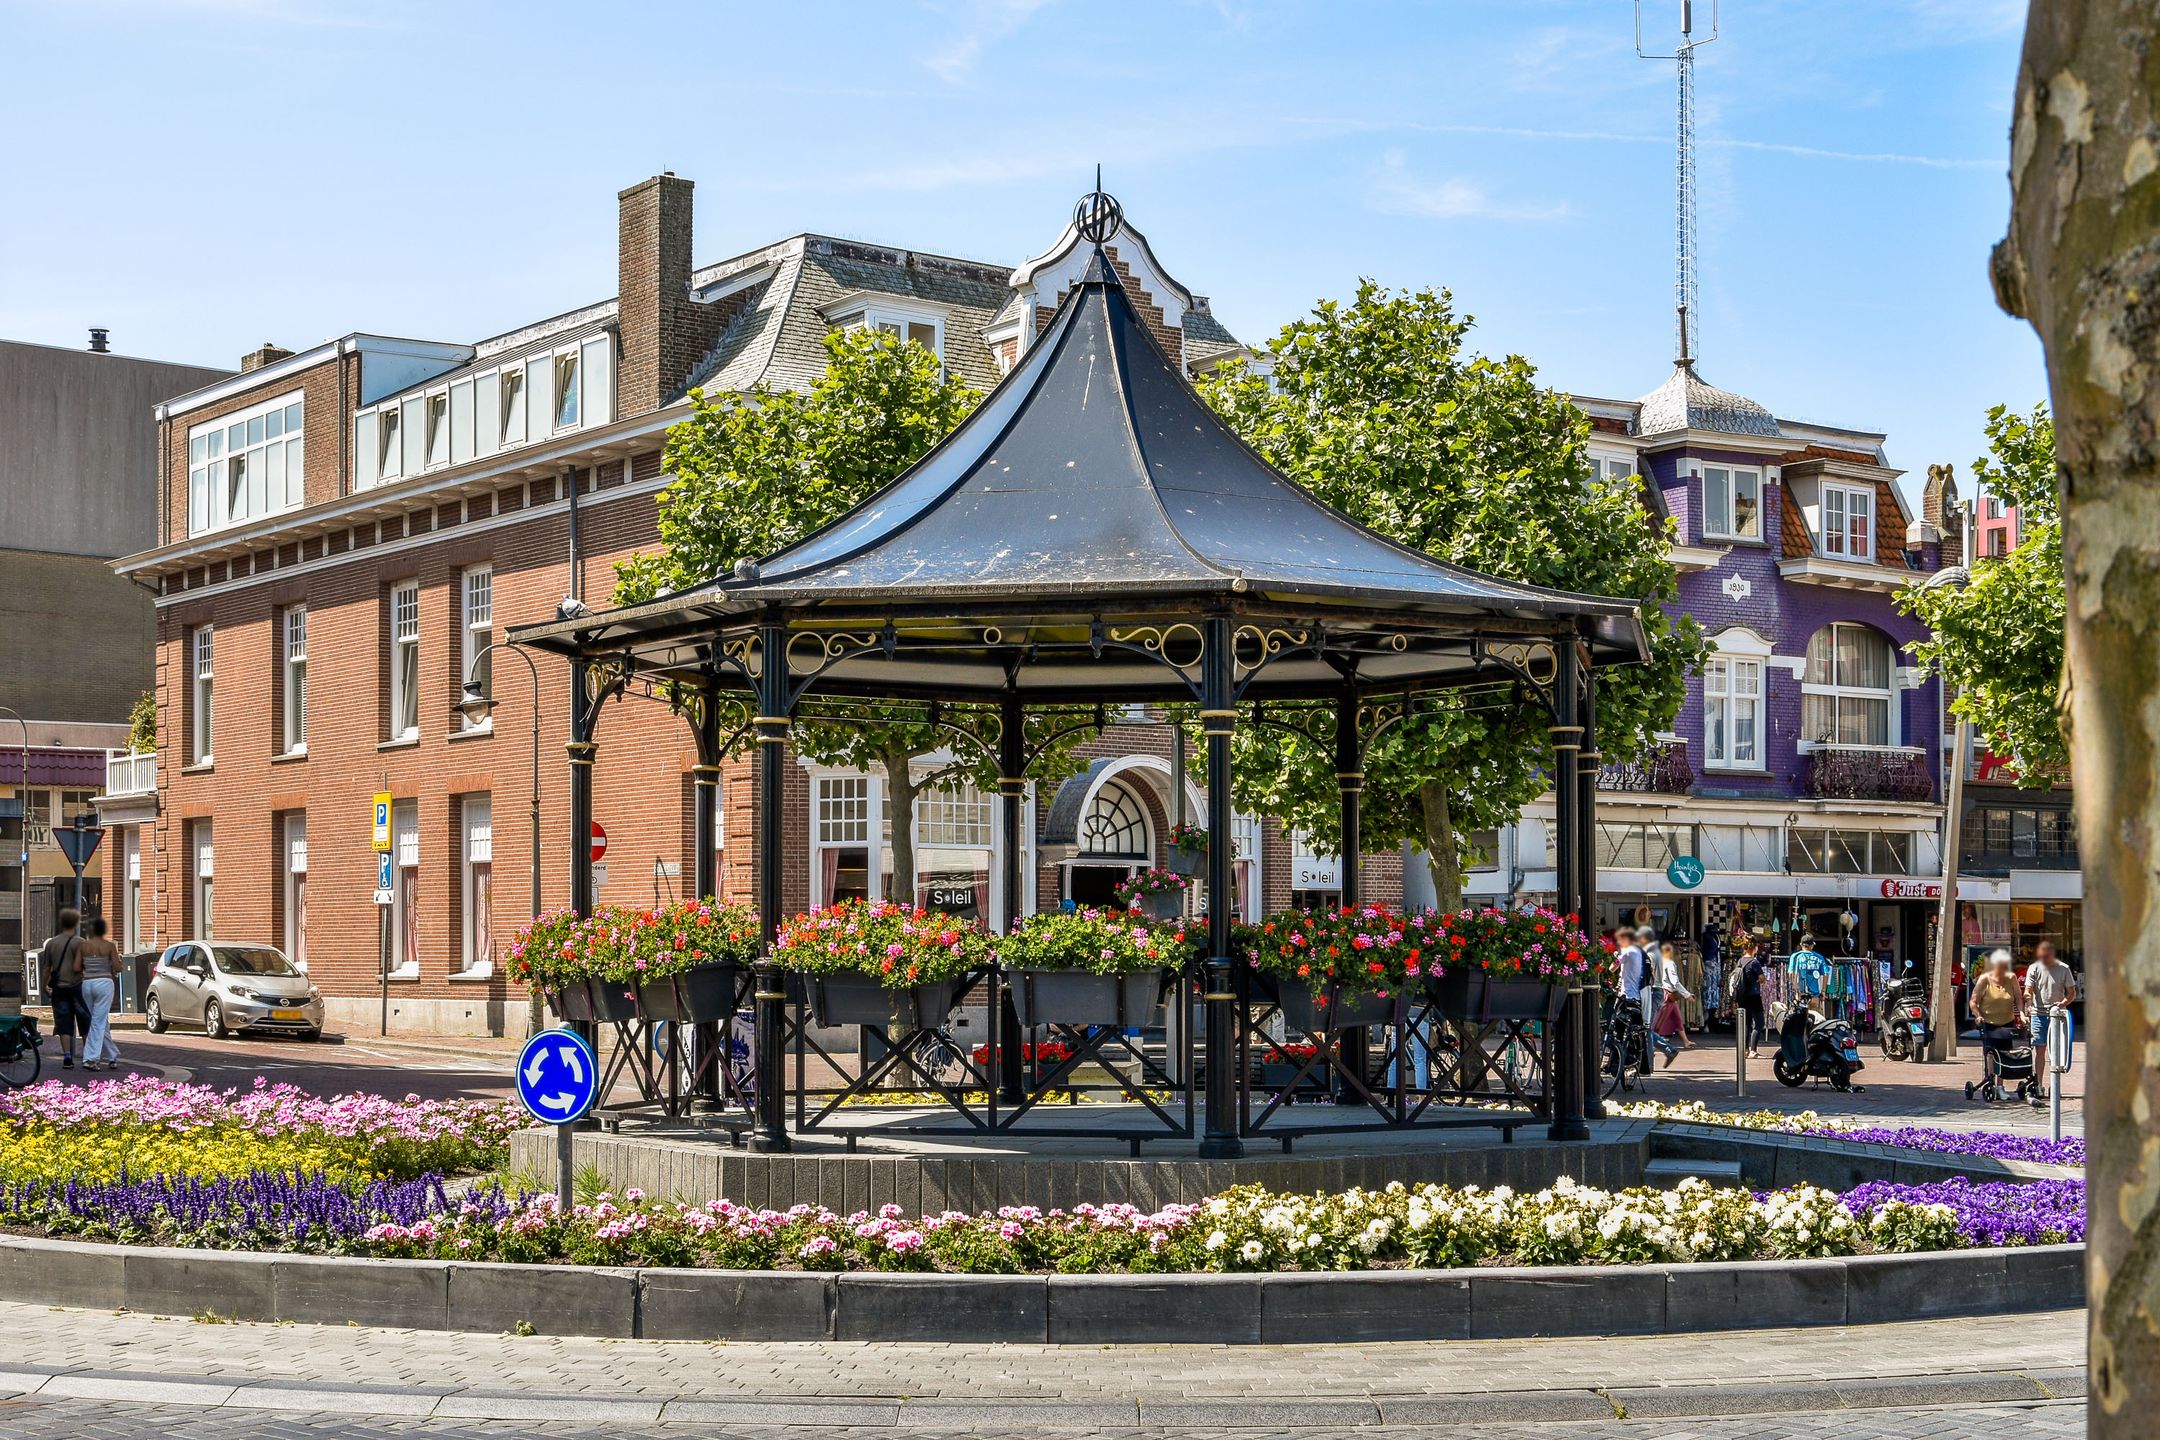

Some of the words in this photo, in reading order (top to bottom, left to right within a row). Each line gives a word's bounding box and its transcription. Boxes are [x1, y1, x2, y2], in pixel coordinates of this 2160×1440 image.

[378, 805, 385, 824] P
[381, 853, 389, 873] P
[1899, 881, 1927, 897] Just
